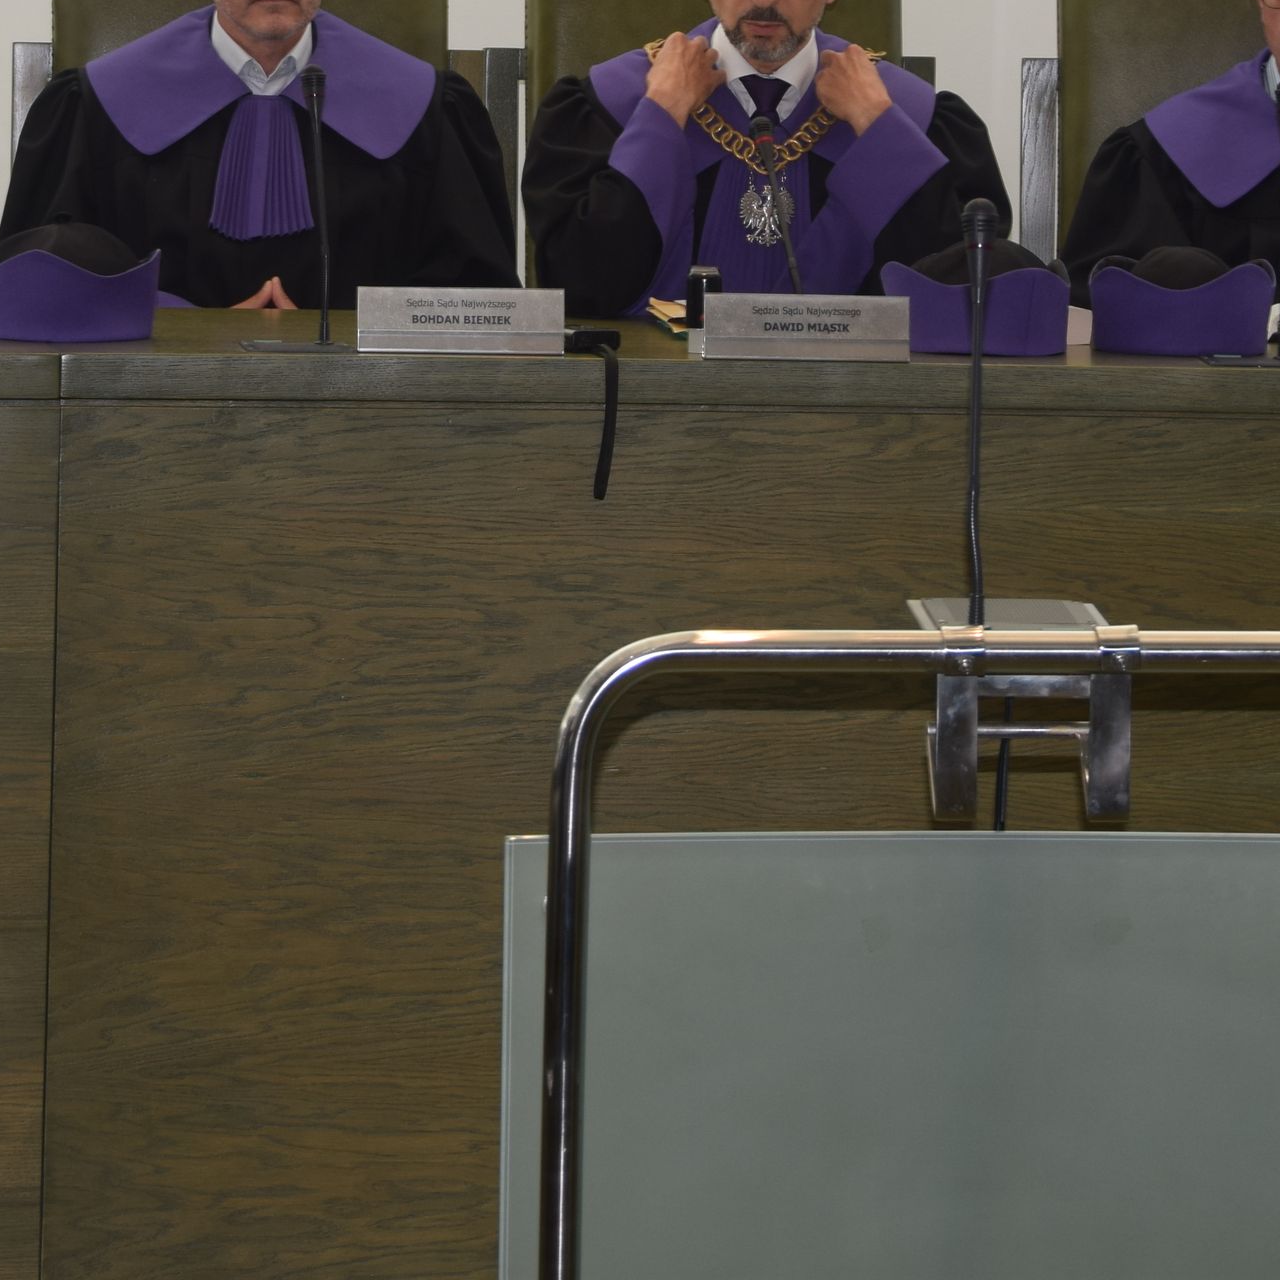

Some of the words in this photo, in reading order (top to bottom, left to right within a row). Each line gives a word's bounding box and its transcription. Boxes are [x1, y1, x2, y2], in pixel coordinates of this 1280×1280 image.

[406, 299, 434, 309] Sędzia
[437, 299, 458, 309] Sądu
[462, 300, 516, 310] Najwyższego
[752, 306, 779, 316] Sędzia
[783, 307, 803, 317] Sądu
[807, 307, 861, 317] Najwyższego
[412, 315, 460, 324] BOHDAN
[464, 316, 511, 325] BIENIEK
[764, 322, 804, 332] DAWID
[808, 323, 850, 334] MIĄSIK
